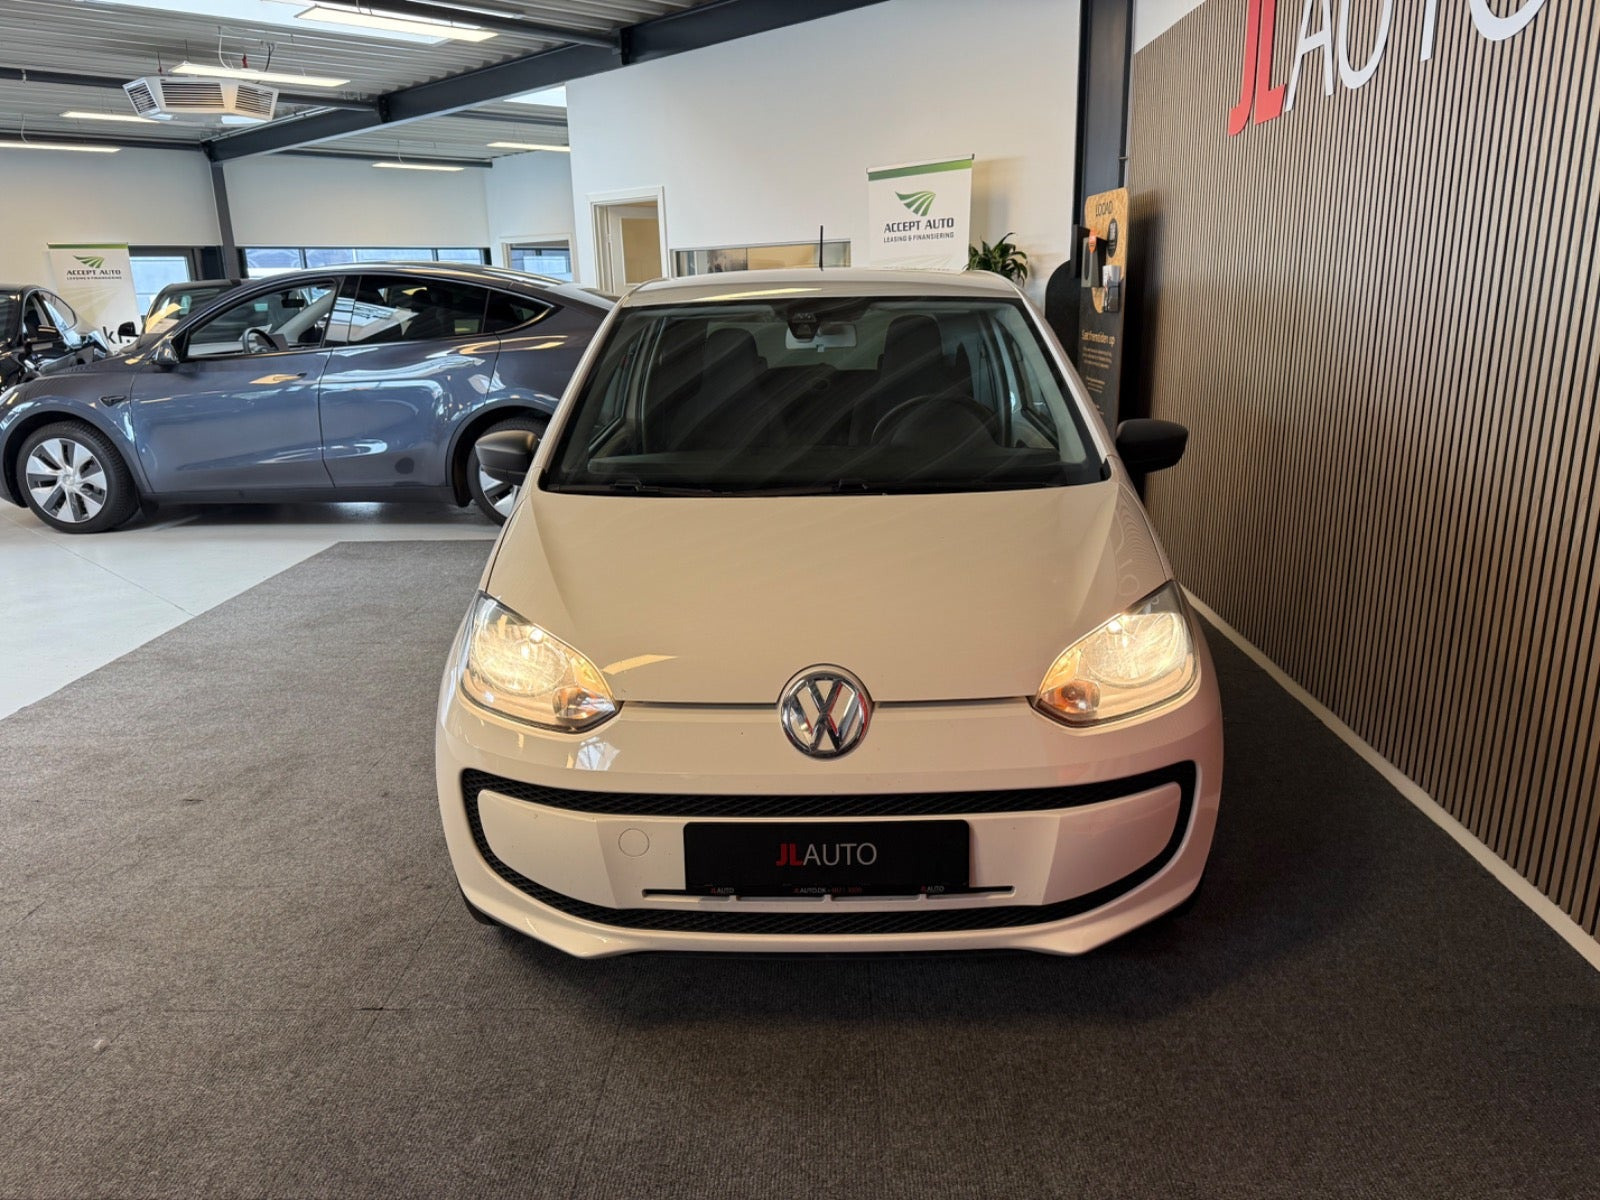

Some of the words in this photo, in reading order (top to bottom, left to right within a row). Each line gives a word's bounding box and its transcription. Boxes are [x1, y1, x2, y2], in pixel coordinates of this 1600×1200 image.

[884, 220, 921, 233] ACCEPT
[925, 217, 954, 230] AUTO
[884, 235, 907, 243] LEASING
[913, 232, 954, 241] FINANSIERING
[775, 842, 878, 867] JLAUTO
